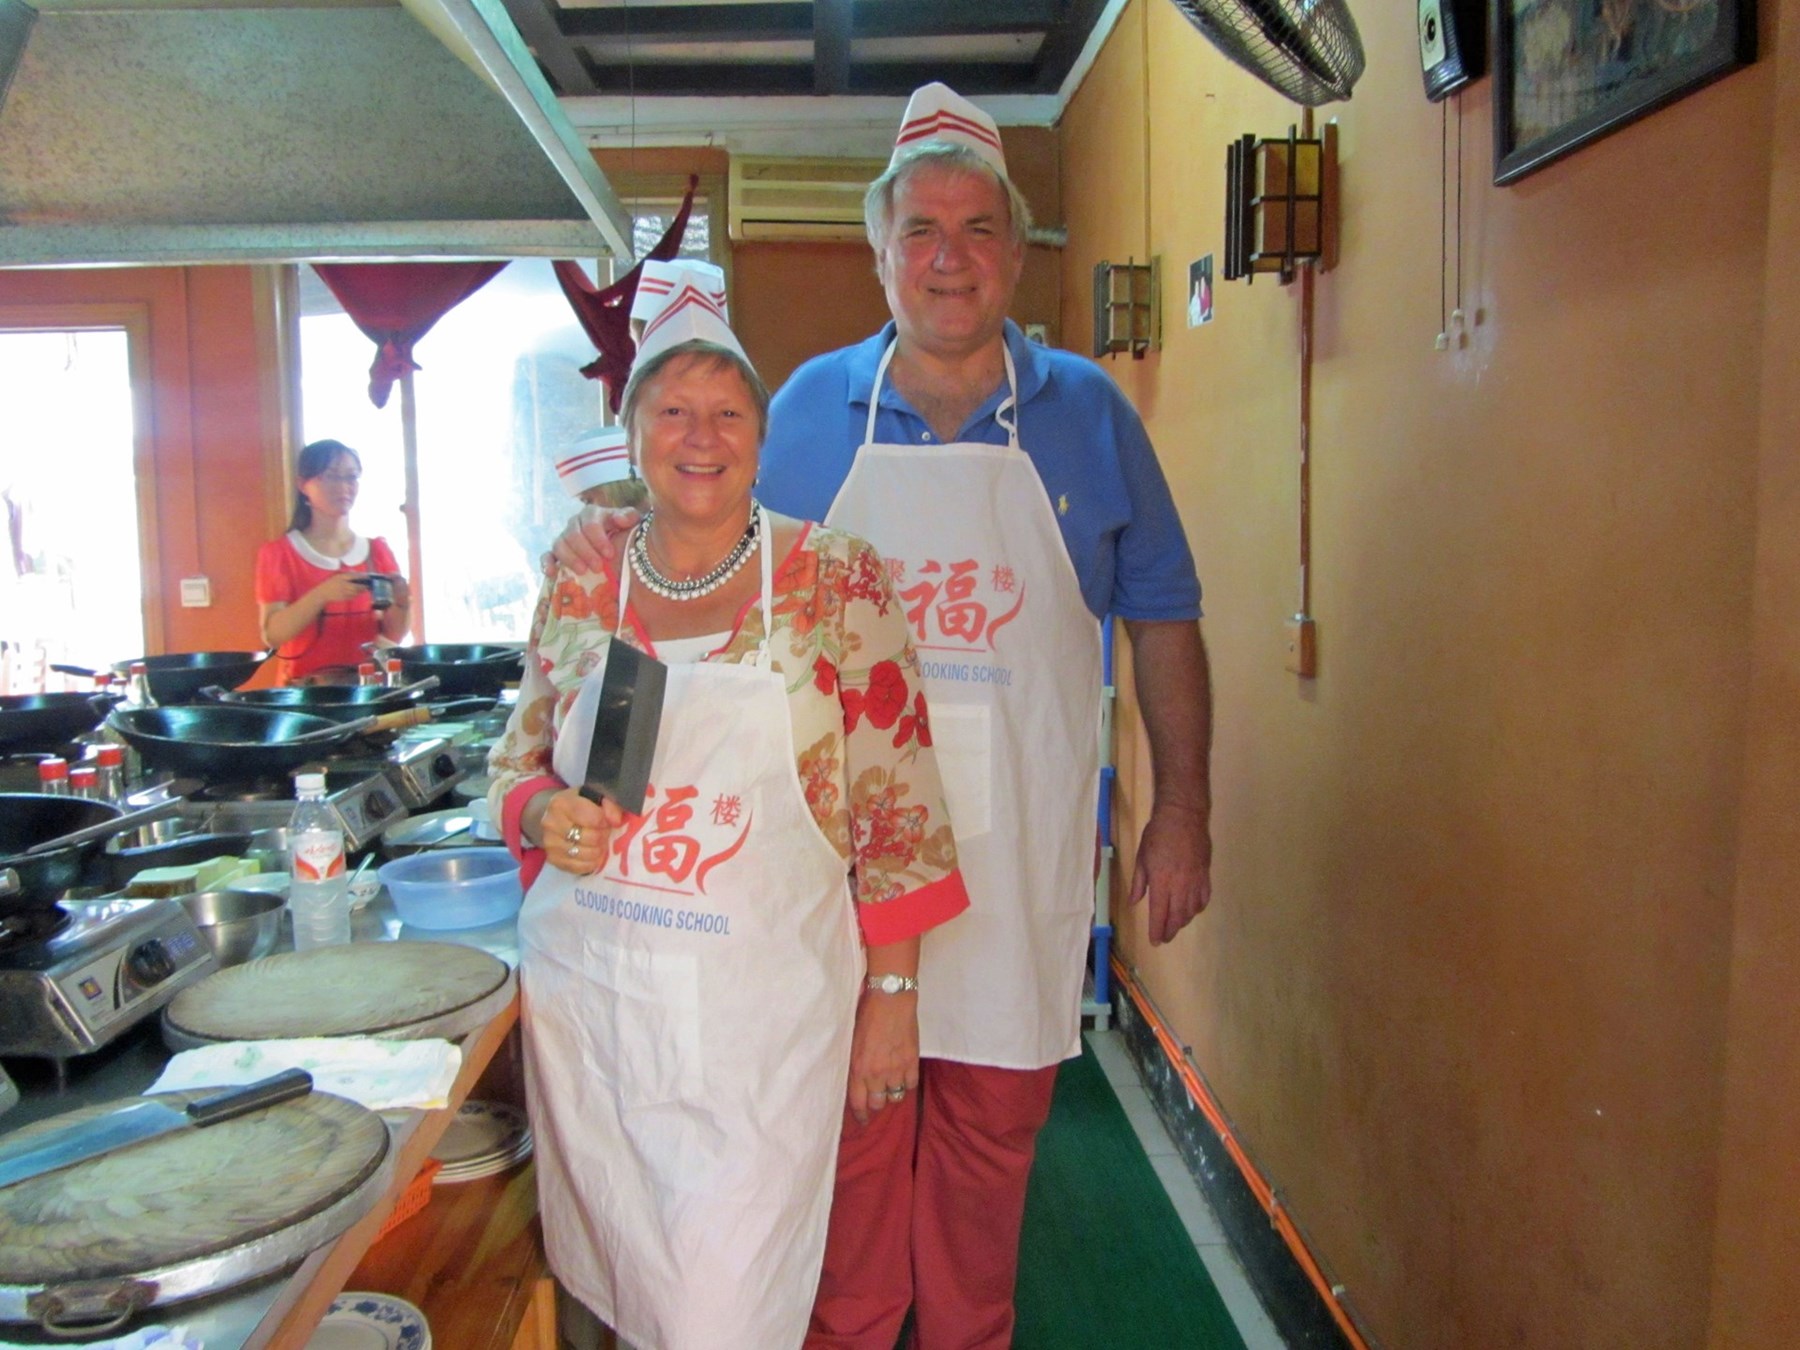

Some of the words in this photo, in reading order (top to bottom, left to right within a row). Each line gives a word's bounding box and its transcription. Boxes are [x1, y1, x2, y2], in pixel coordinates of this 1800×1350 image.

[922, 662, 969, 681] OOKING
[972, 665, 1012, 686] SCHOOL
[574, 887, 607, 913] CLOUD
[616, 899, 673, 928] COOKING
[675, 910, 731, 935] SCHOOL
